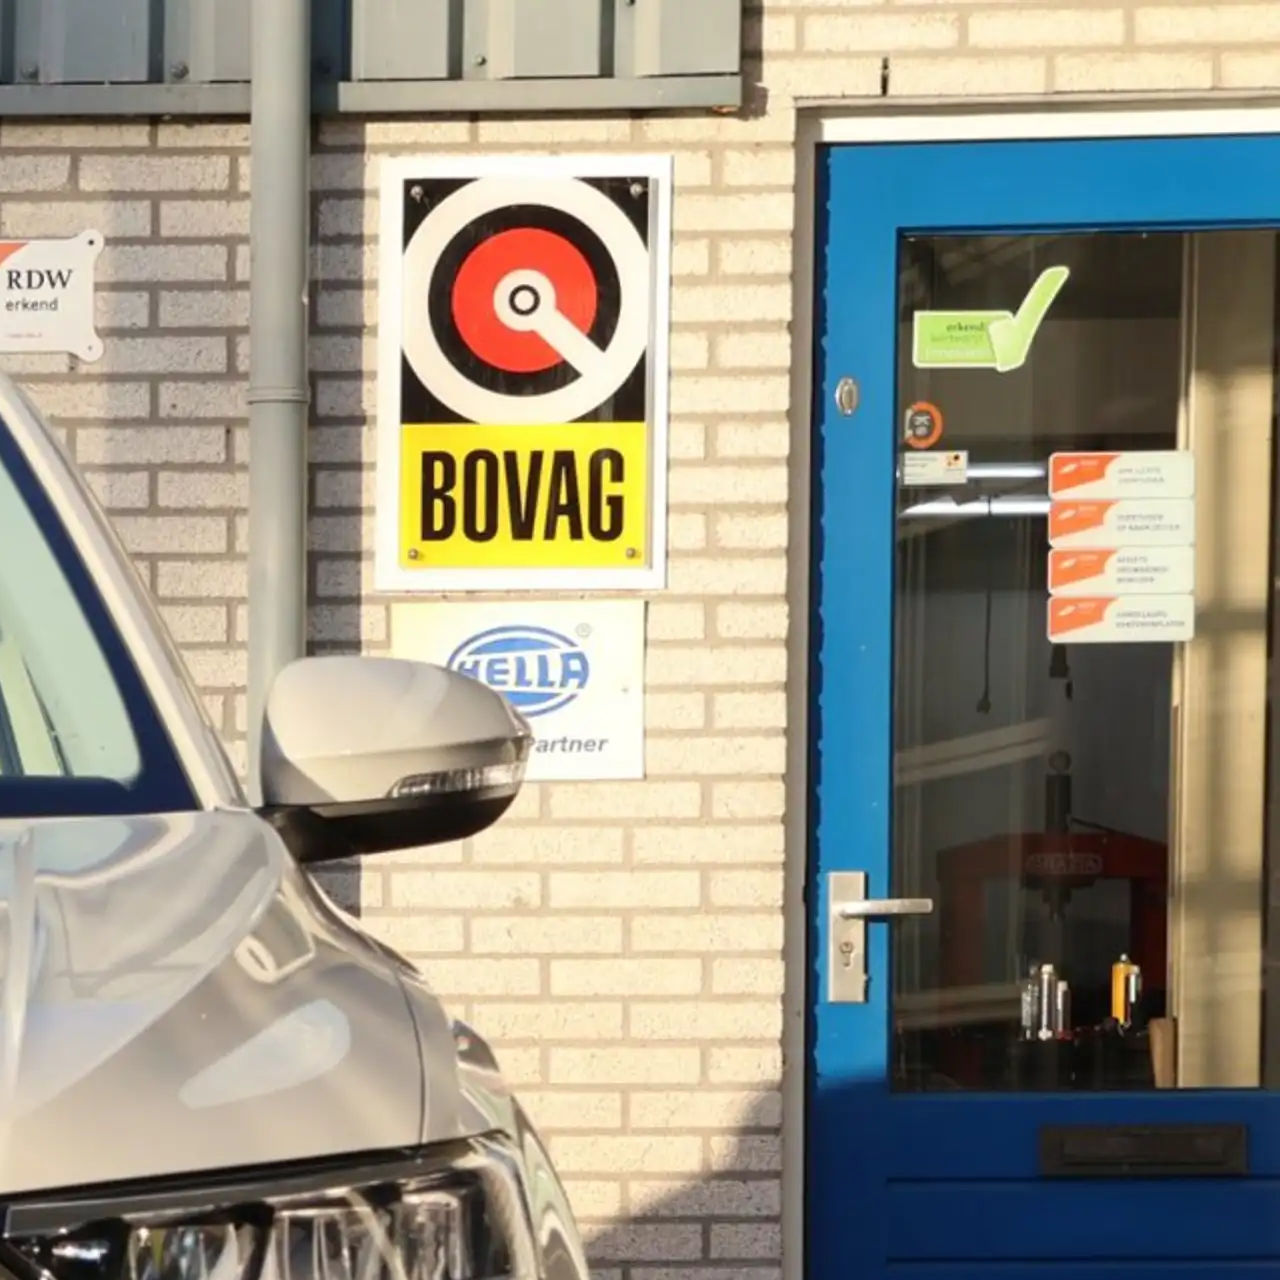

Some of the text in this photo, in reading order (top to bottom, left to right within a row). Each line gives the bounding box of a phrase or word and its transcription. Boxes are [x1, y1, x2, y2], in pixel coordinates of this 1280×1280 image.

[6, 268, 73, 290] RDW
[5, 297, 59, 312] erkend
[420, 447, 625, 543] BOVAG
[457, 650, 590, 690] HELLA
